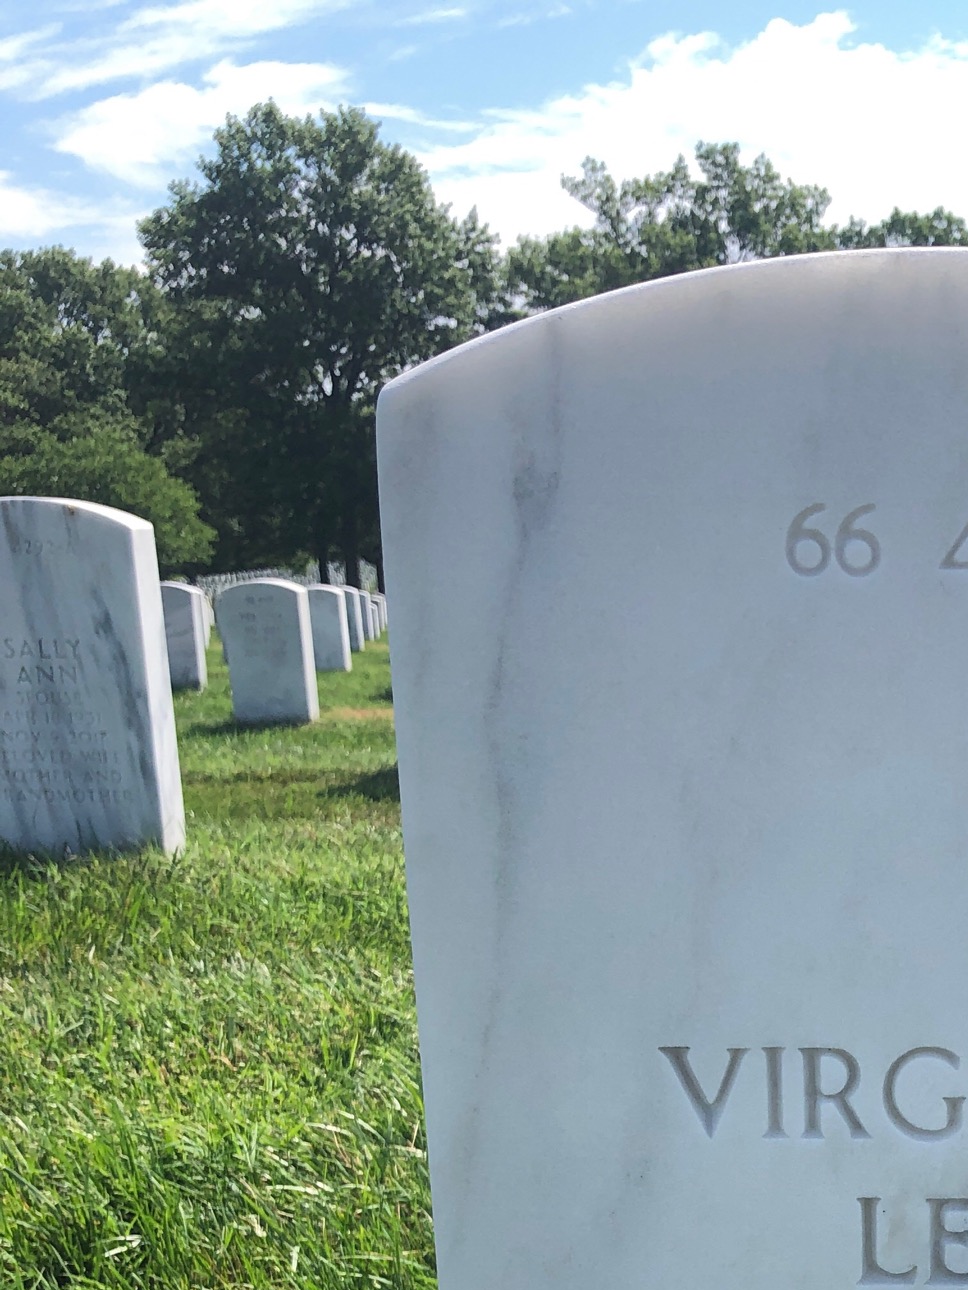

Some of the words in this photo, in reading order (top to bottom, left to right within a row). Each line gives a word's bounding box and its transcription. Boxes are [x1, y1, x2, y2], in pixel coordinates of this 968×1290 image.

[785, 503, 882, 577] 66
[4, 637, 80, 659] SALLY
[17, 665, 78, 685] ANN
